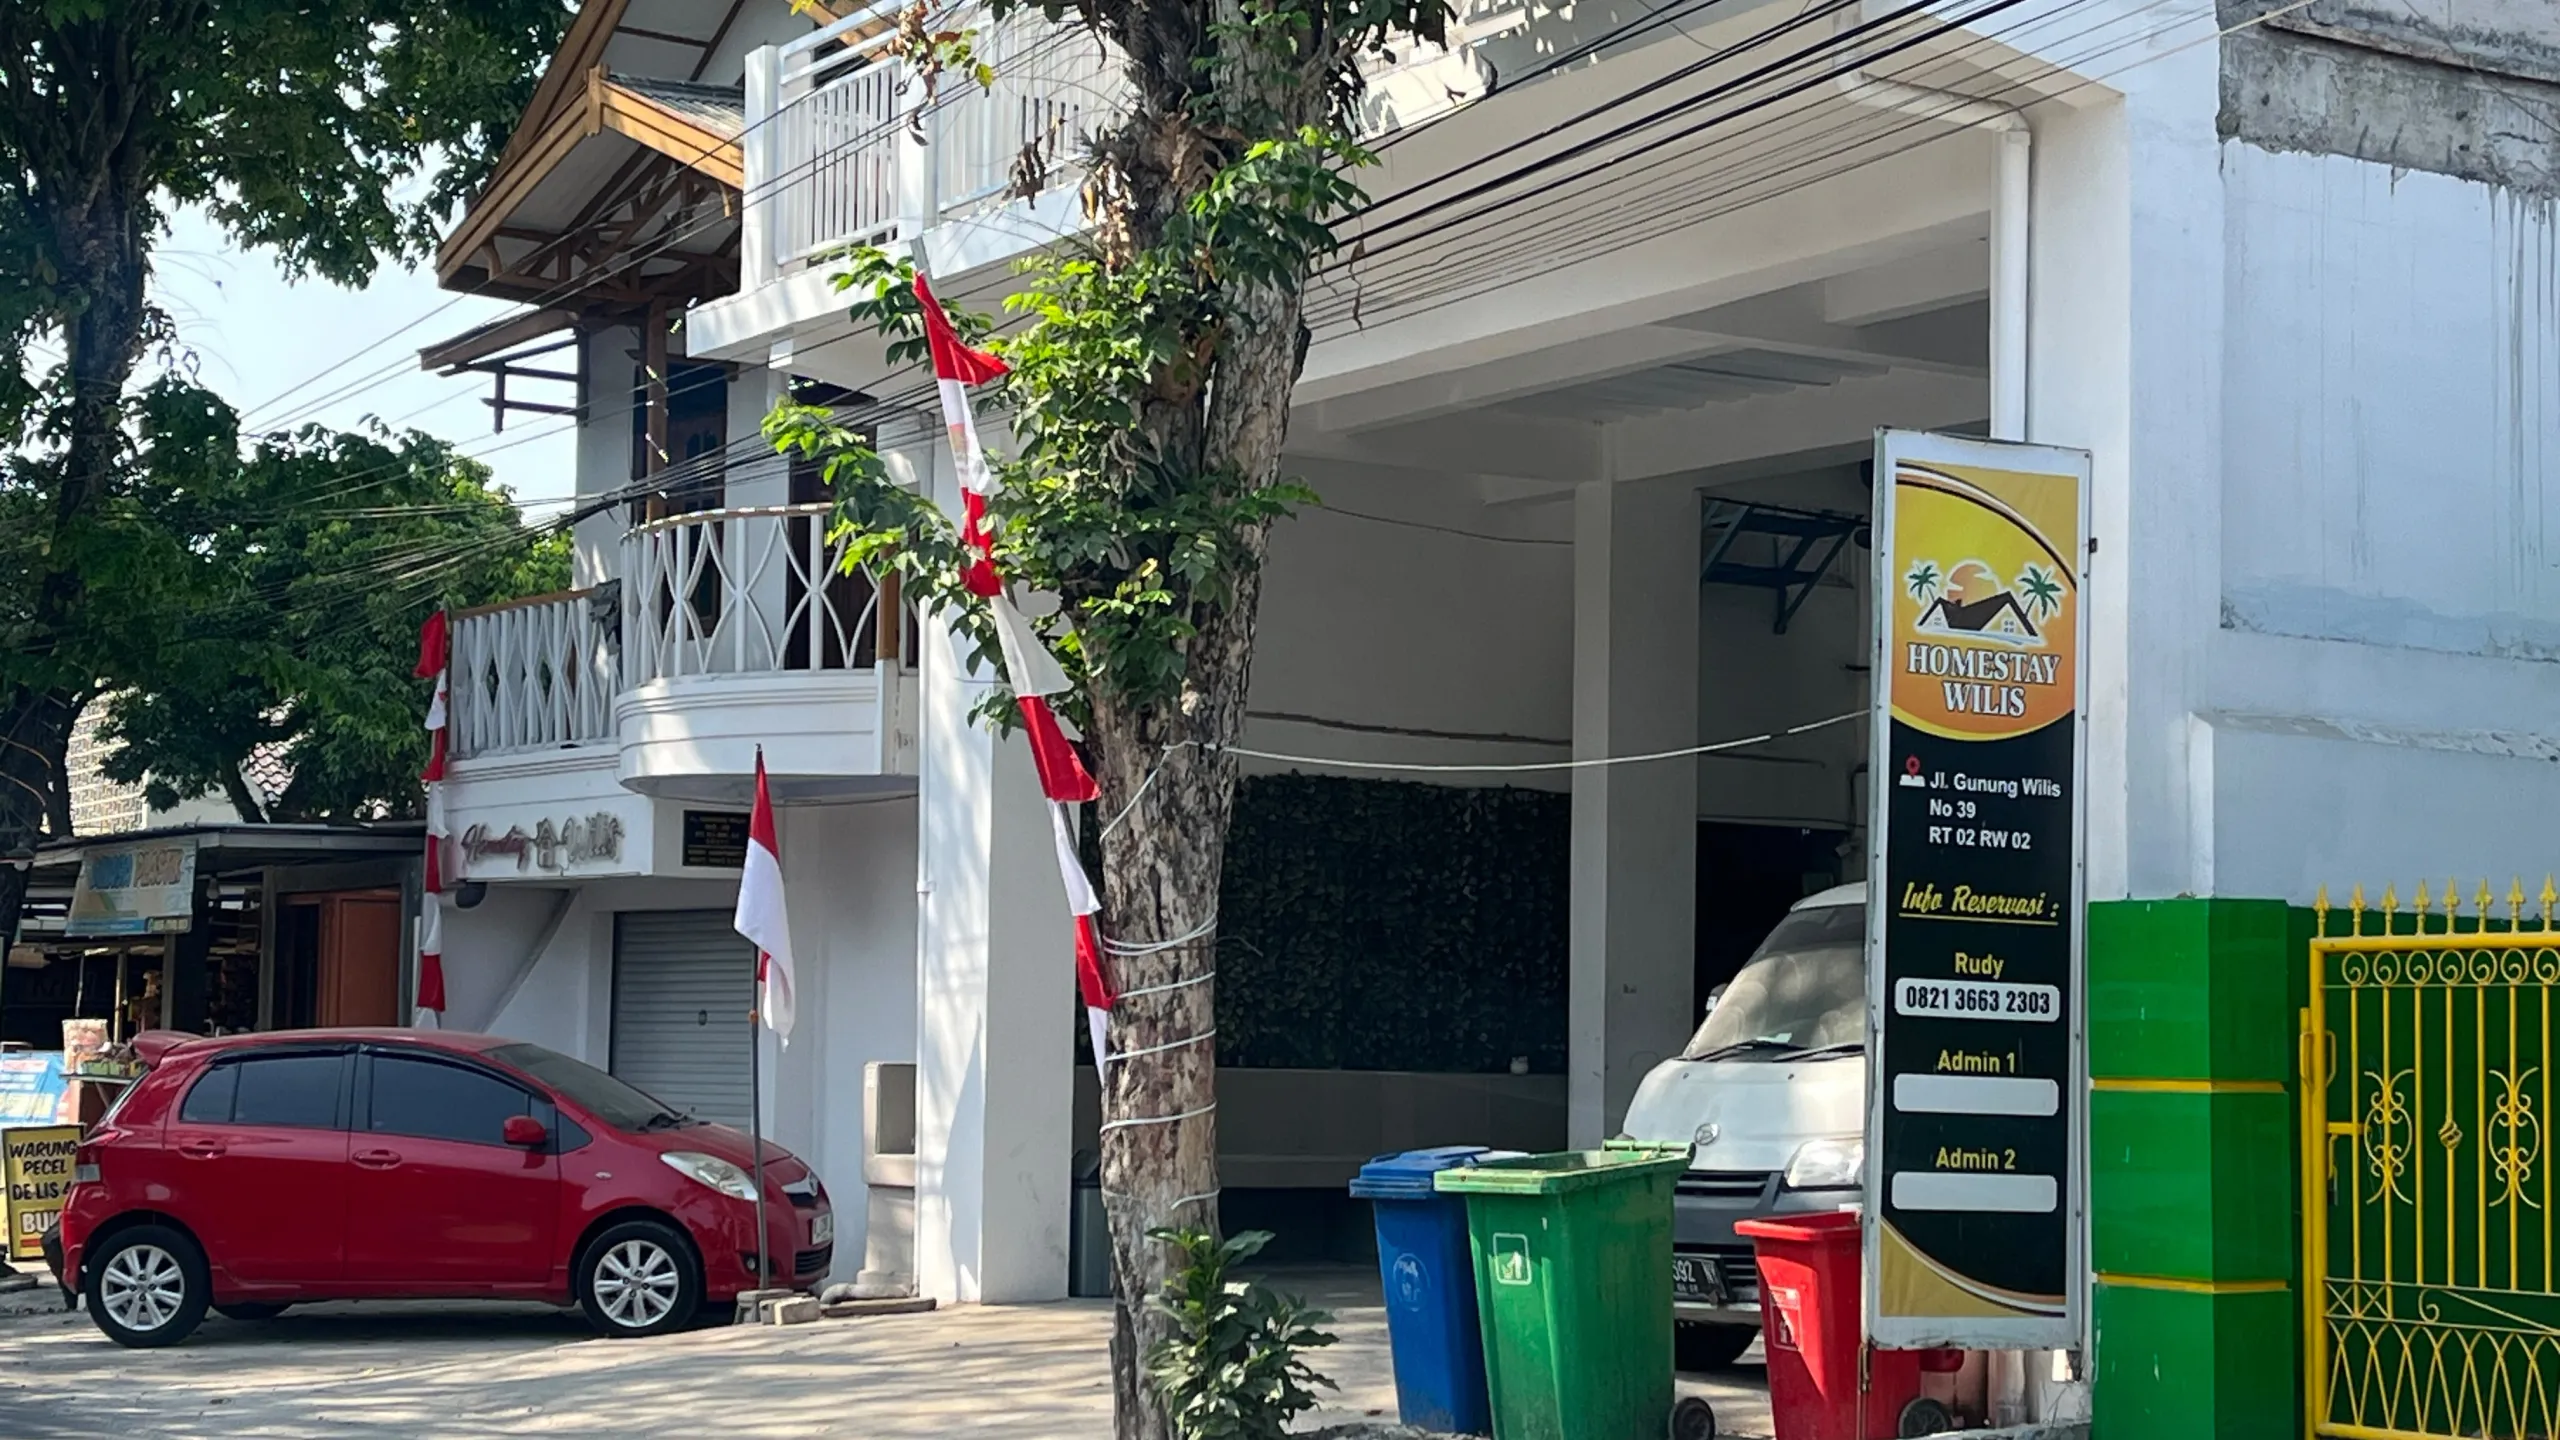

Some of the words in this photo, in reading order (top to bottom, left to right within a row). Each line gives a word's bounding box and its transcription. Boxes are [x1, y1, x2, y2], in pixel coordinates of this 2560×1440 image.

[1906, 642, 2061, 685] HOMESTAY
[1942, 680, 2025, 717] WILIS
[1930, 771, 1949, 789] Jl.
[1953, 772, 2018, 799] Gunung
[2021, 777, 2061, 797] Wilis
[1929, 799, 1953, 817] No
[1956, 800, 1977, 818] 39
[1929, 826, 1952, 844] RT
[1956, 828, 1976, 846] 02
[1979, 829, 2009, 848] RW
[2011, 832, 2032, 850] 02
[1901, 881, 1943, 913] Info
[1951, 884, 2047, 916] Reservasi
[1954, 951, 2005, 980] Rudy
[1906, 985, 1949, 1010] 0821
[1954, 988, 2000, 1012] 3663
[2005, 990, 2051, 1015] 2303
[1937, 1049, 2001, 1073] Admin
[2006, 1051, 2016, 1074] 1
[9, 1140, 77, 1158] WARUNG
[1935, 1146, 1999, 1170] Admin
[2003, 1148, 2017, 1170] 2
[23, 1158, 67, 1176] PECEL
